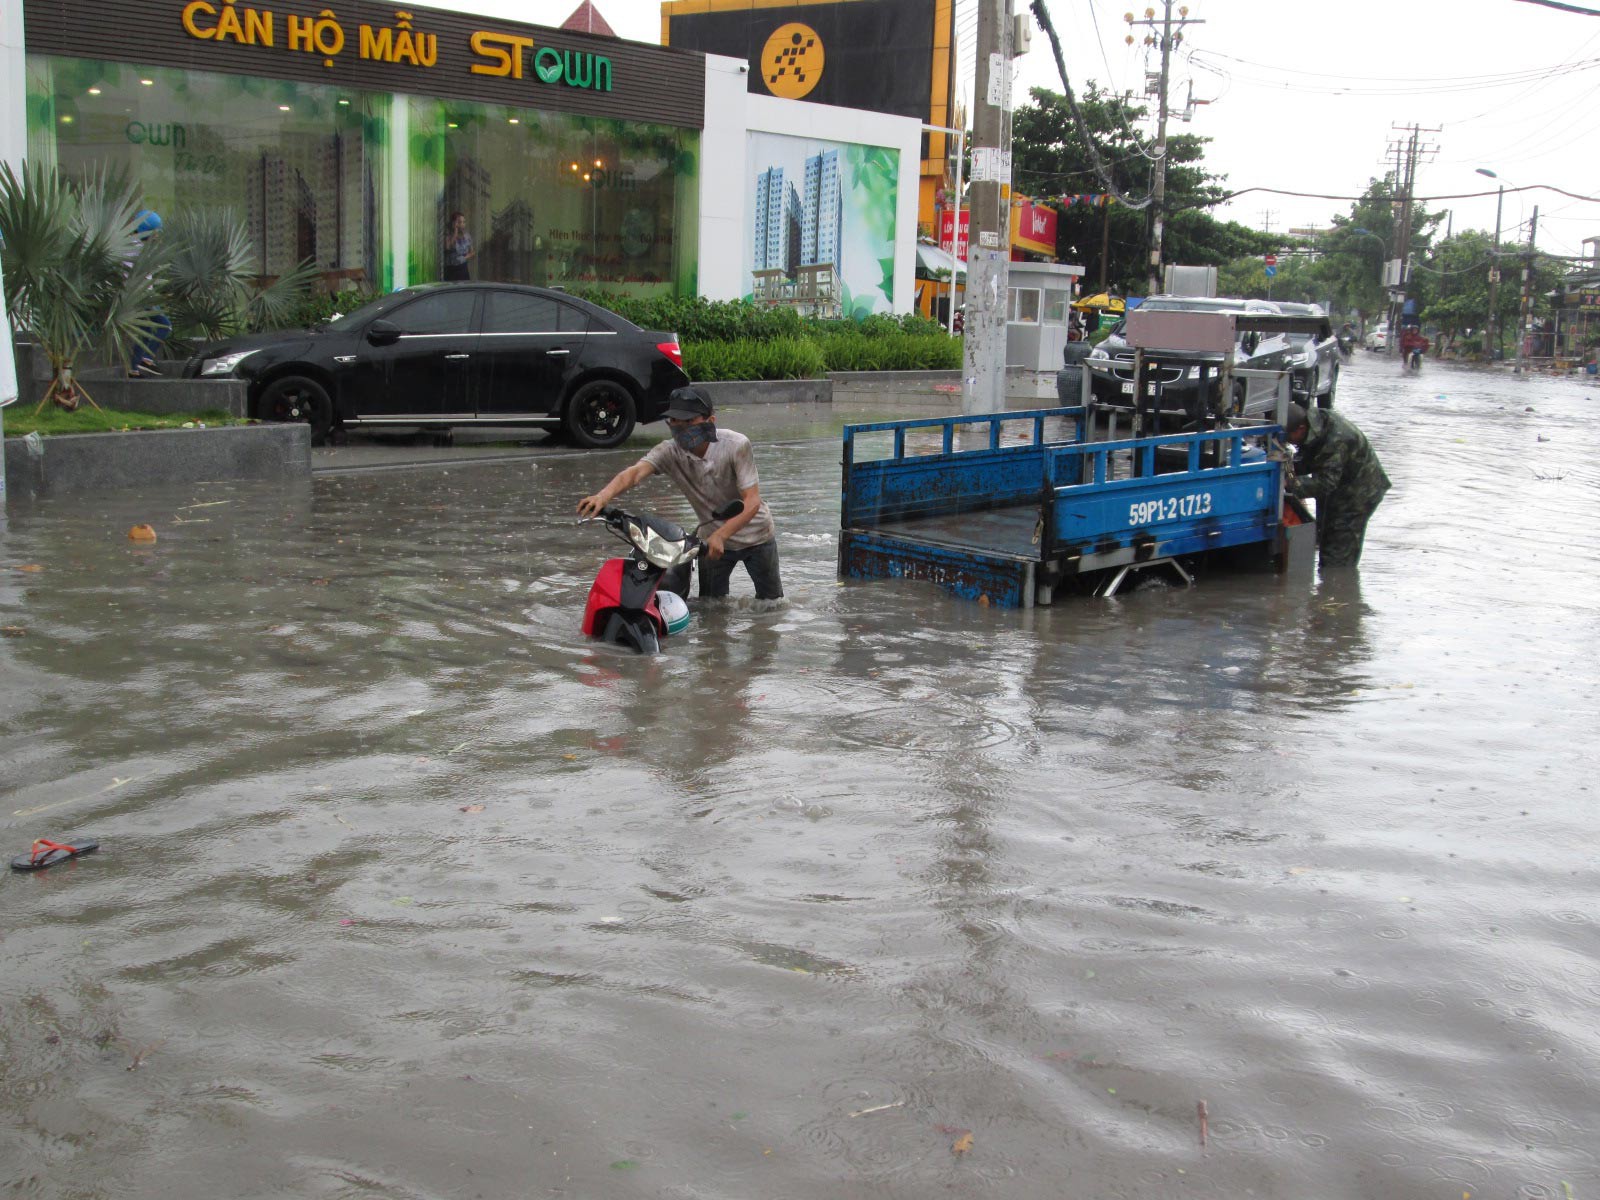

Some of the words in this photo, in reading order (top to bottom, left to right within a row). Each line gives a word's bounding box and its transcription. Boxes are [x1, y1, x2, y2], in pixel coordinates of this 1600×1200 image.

[182, 0, 274, 47] CĂN
[288, 9, 345, 68] HỘ
[359, 11, 438, 67] MẪU
[1128, 493, 1212, 526] 59P1-21713
